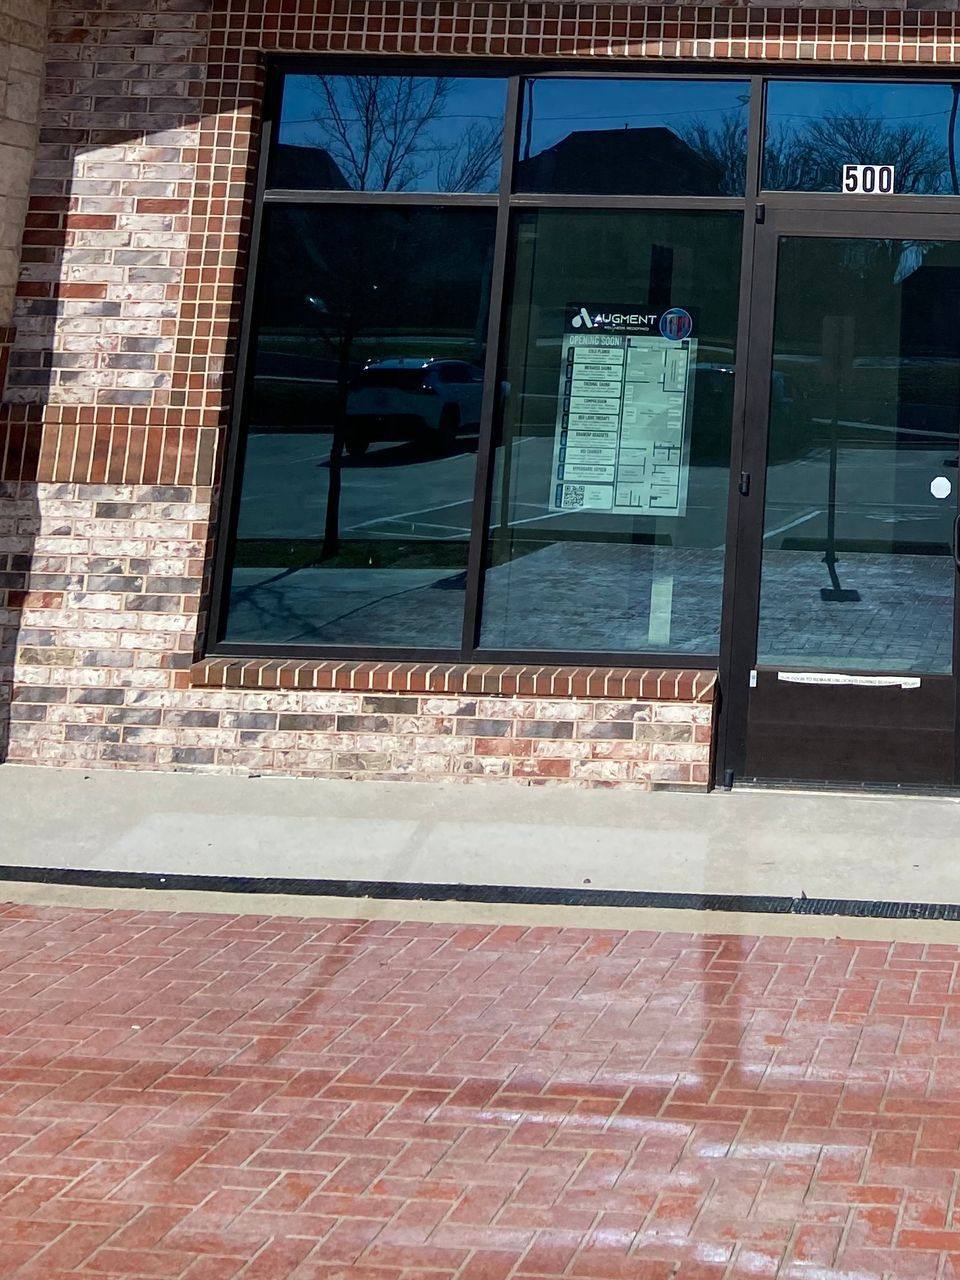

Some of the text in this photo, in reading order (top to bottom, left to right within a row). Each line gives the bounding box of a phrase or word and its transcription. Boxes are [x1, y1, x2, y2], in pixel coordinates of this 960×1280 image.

[845, 165, 892, 192] 500
[594, 314, 657, 325] AUGMENT
[569, 335, 623, 346] OPENING SOON!
